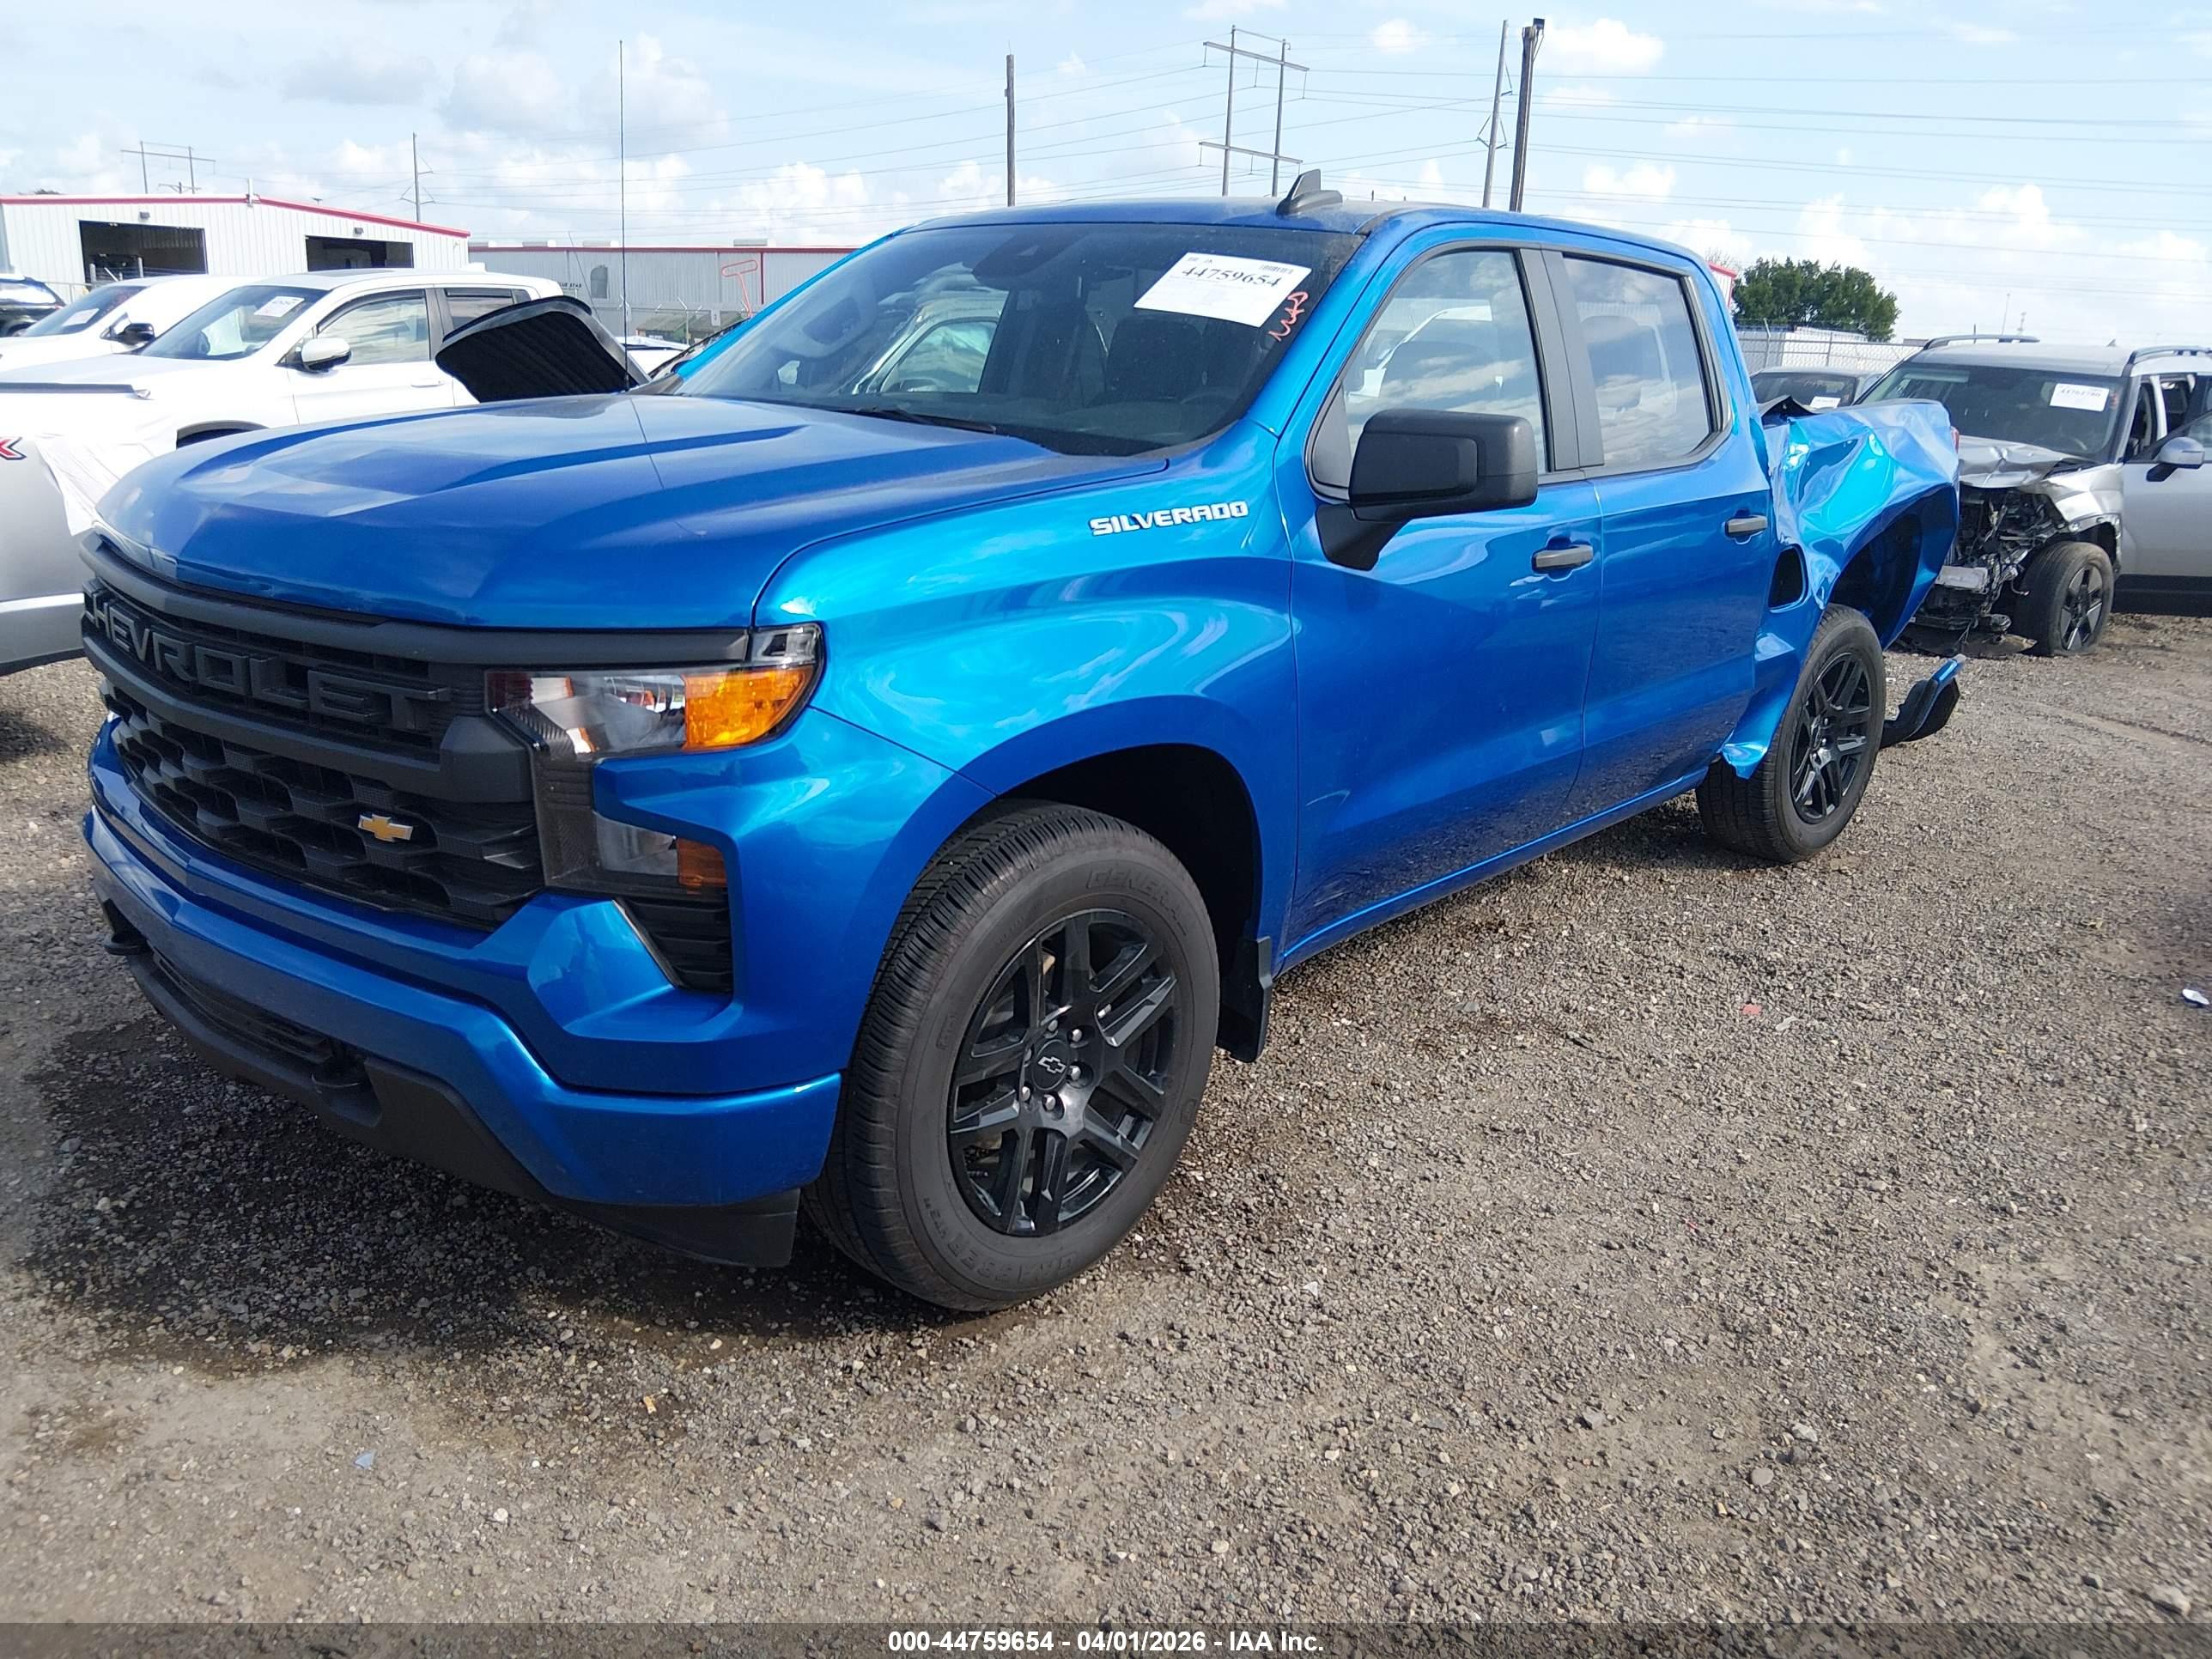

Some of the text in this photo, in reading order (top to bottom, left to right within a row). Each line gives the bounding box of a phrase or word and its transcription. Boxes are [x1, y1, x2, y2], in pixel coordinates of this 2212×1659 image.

[1181, 265, 1282, 288] 44759654
[1089, 501, 1249, 537] SILVERADO
[82, 579, 453, 732] CHEVROLET
